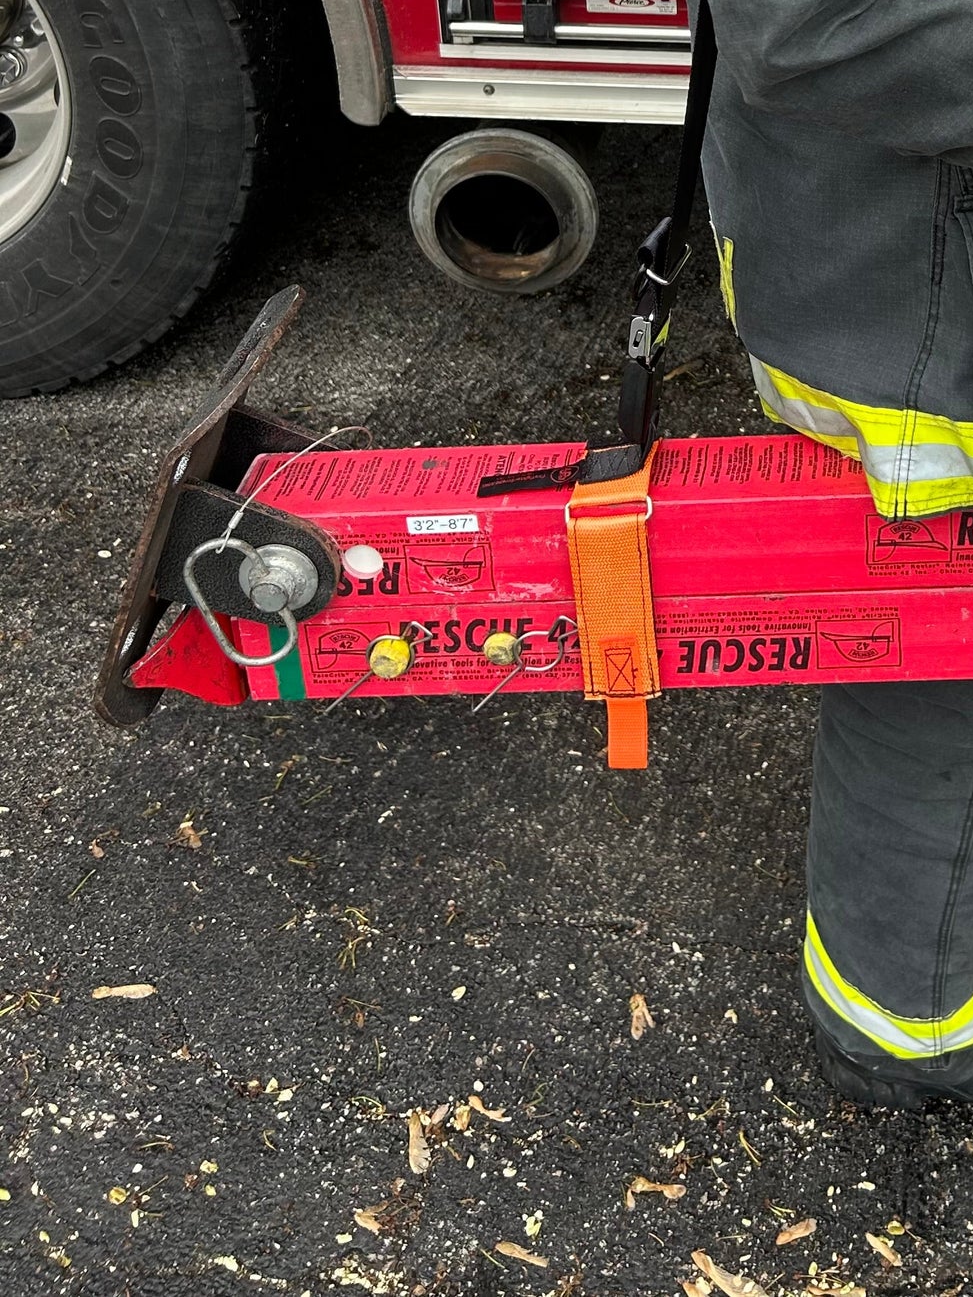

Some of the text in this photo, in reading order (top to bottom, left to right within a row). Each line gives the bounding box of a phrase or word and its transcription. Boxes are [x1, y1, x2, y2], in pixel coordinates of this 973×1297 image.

[898, 531, 913, 541] 42
[446, 567, 461, 575] 42
[670, 626, 719, 635] Extrication
[722, 624, 736, 633] for
[738, 624, 761, 633] Tools
[764, 622, 812, 632] Innovative
[339, 640, 354, 650] 42
[856, 641, 870, 650] 42
[676, 636, 811, 674] RESCUE
[451, 658, 474, 668] Tools
